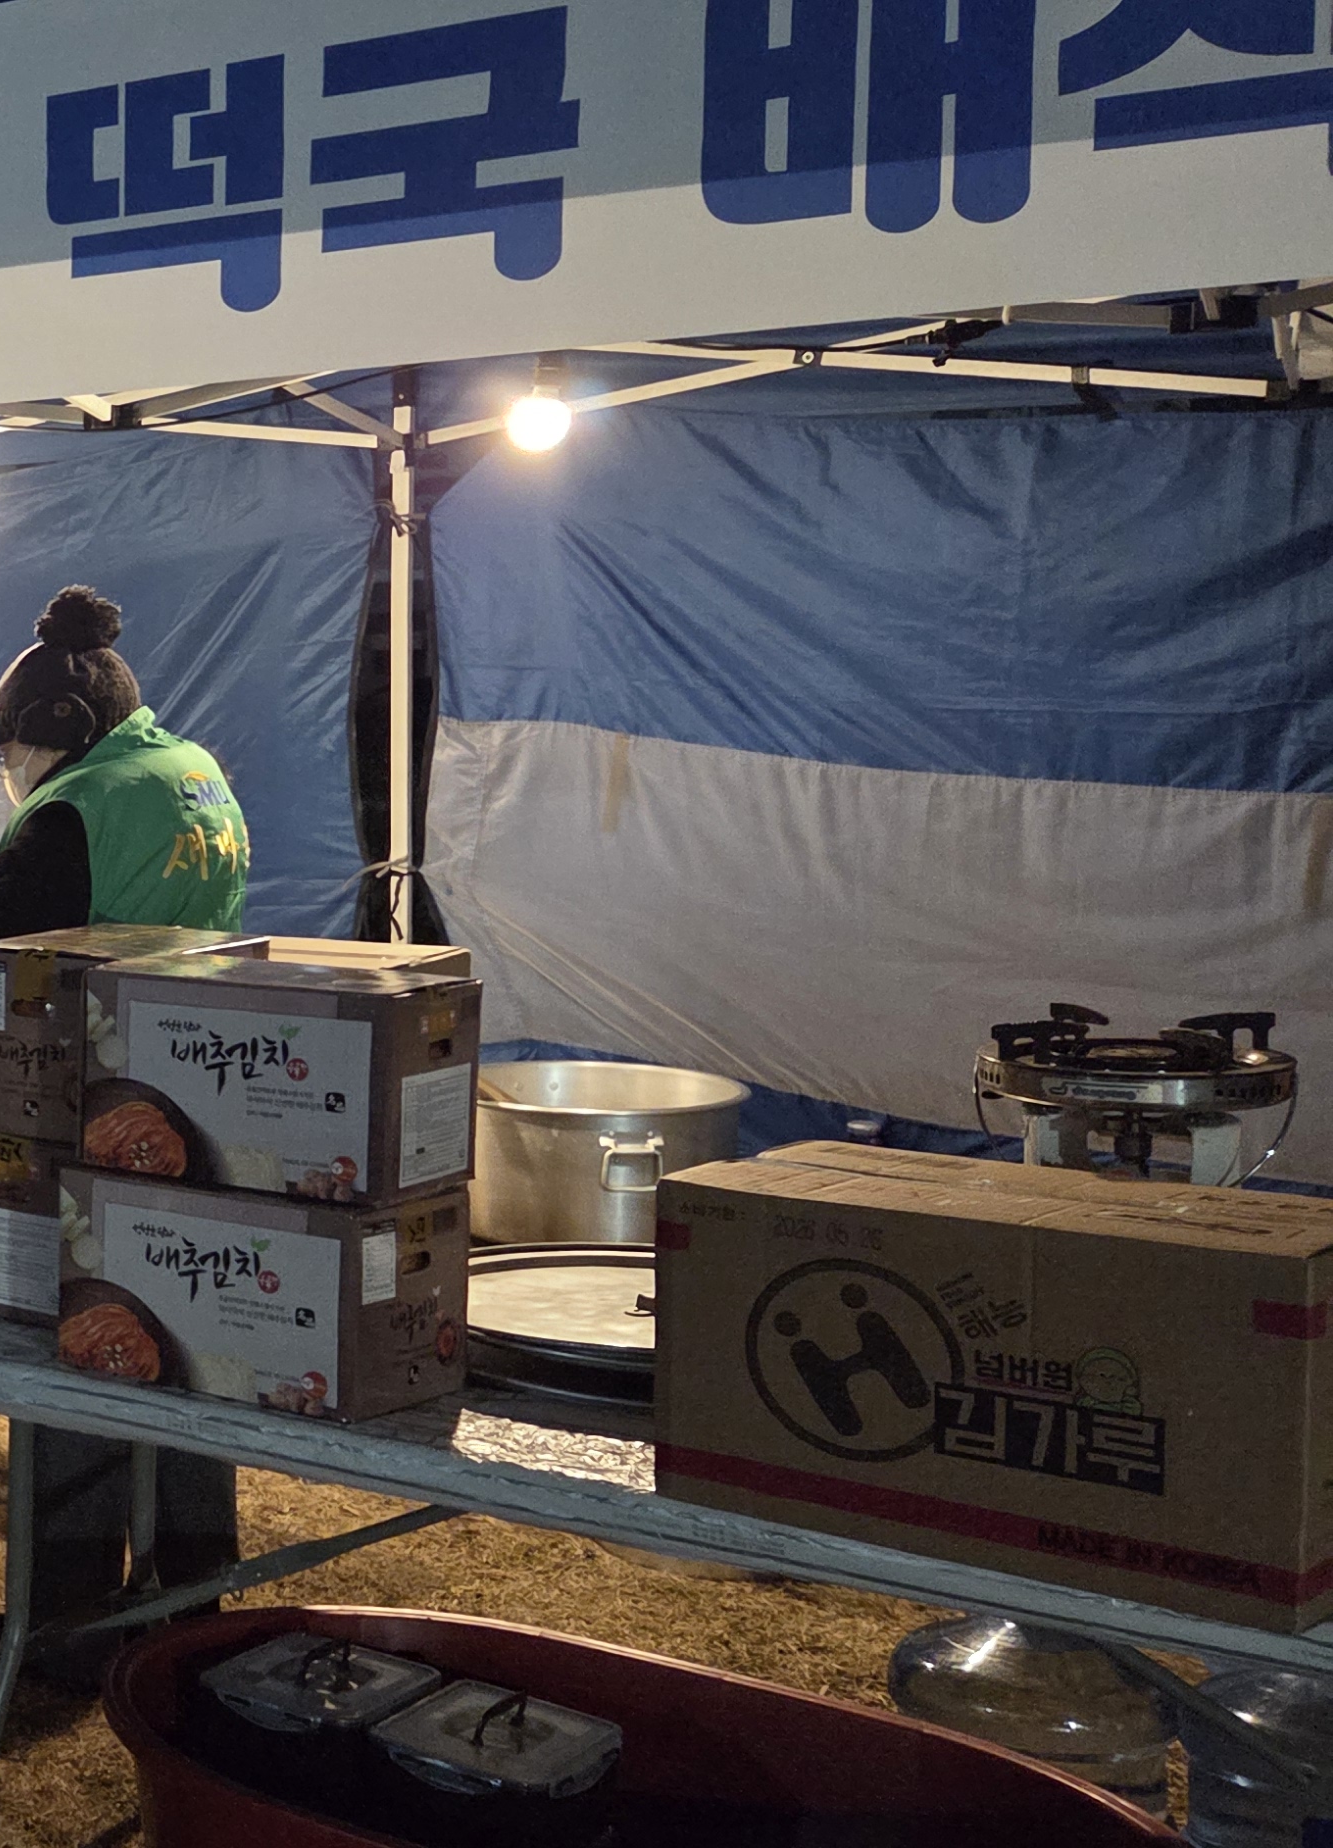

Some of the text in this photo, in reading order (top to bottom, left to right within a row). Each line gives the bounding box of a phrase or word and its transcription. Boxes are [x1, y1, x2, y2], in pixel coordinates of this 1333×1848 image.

[47, 3, 581, 313] 떡국
[162, 816, 252, 881] 새마
[170, 1029, 290, 1097] 배추김치
[144, 1233, 262, 1303] 배추김치
[974, 1349, 1073, 1392] 넘버원
[937, 1387, 1163, 1484] 김가루
[1037, 1522, 1265, 1592] MADE IN KOREA
